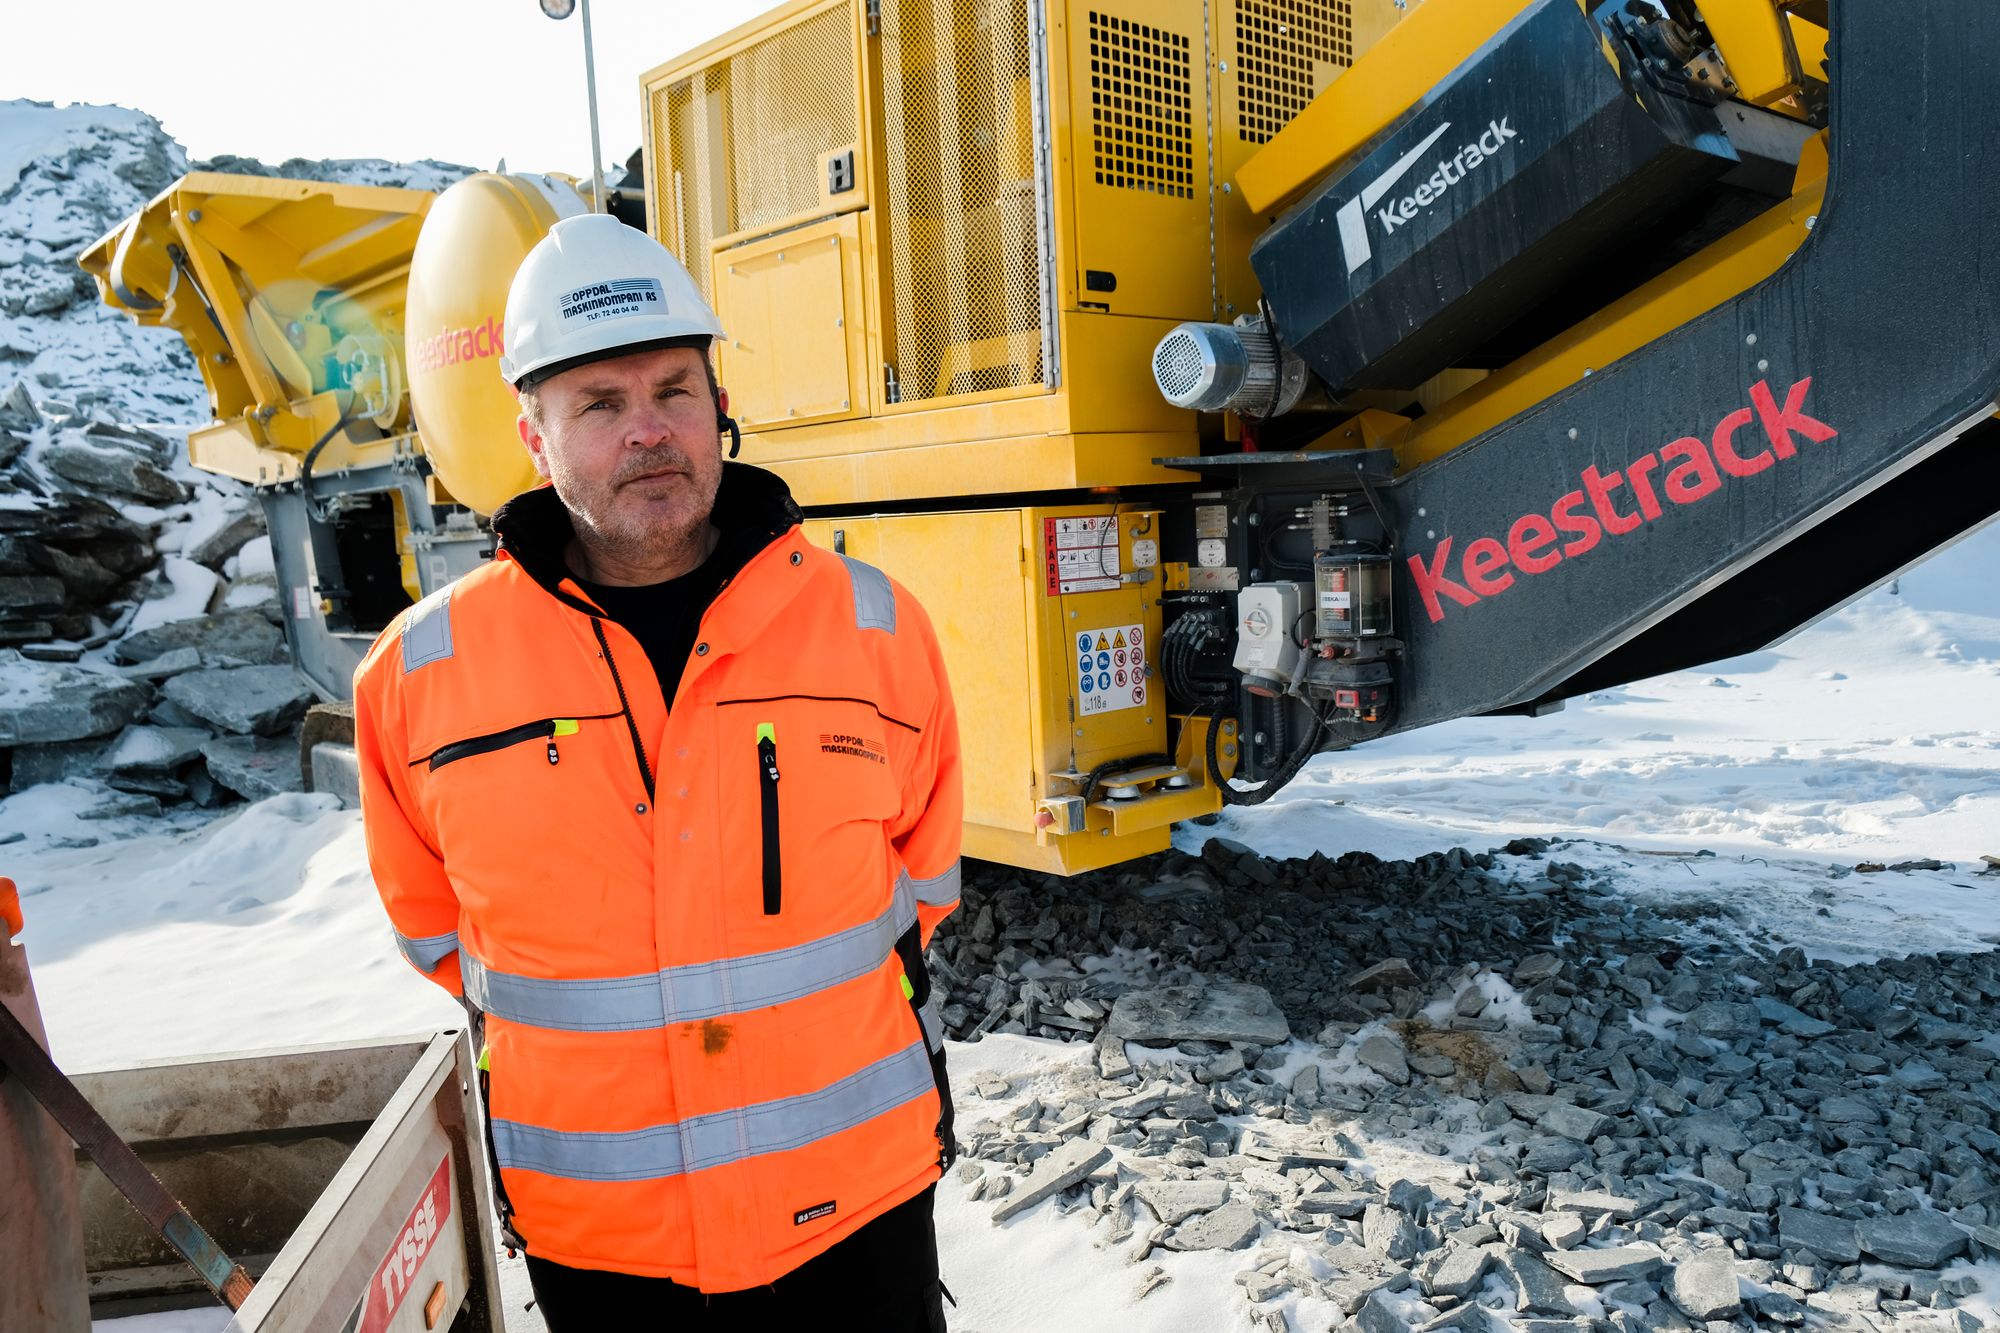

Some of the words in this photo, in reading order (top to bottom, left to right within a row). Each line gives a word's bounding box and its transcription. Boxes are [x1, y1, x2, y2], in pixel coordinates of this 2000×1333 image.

[1378, 116, 1518, 236] Keestrack
[562, 292, 643, 319] MASKINKOMPANI
[645, 291, 657, 302] AS
[572, 284, 612, 302] OPPDAL
[412, 315, 505, 375] eestrack
[1407, 376, 1839, 624] Keestrack
[833, 735, 864, 747] OPPDAL
[382, 1189, 437, 1315] TYSSE
